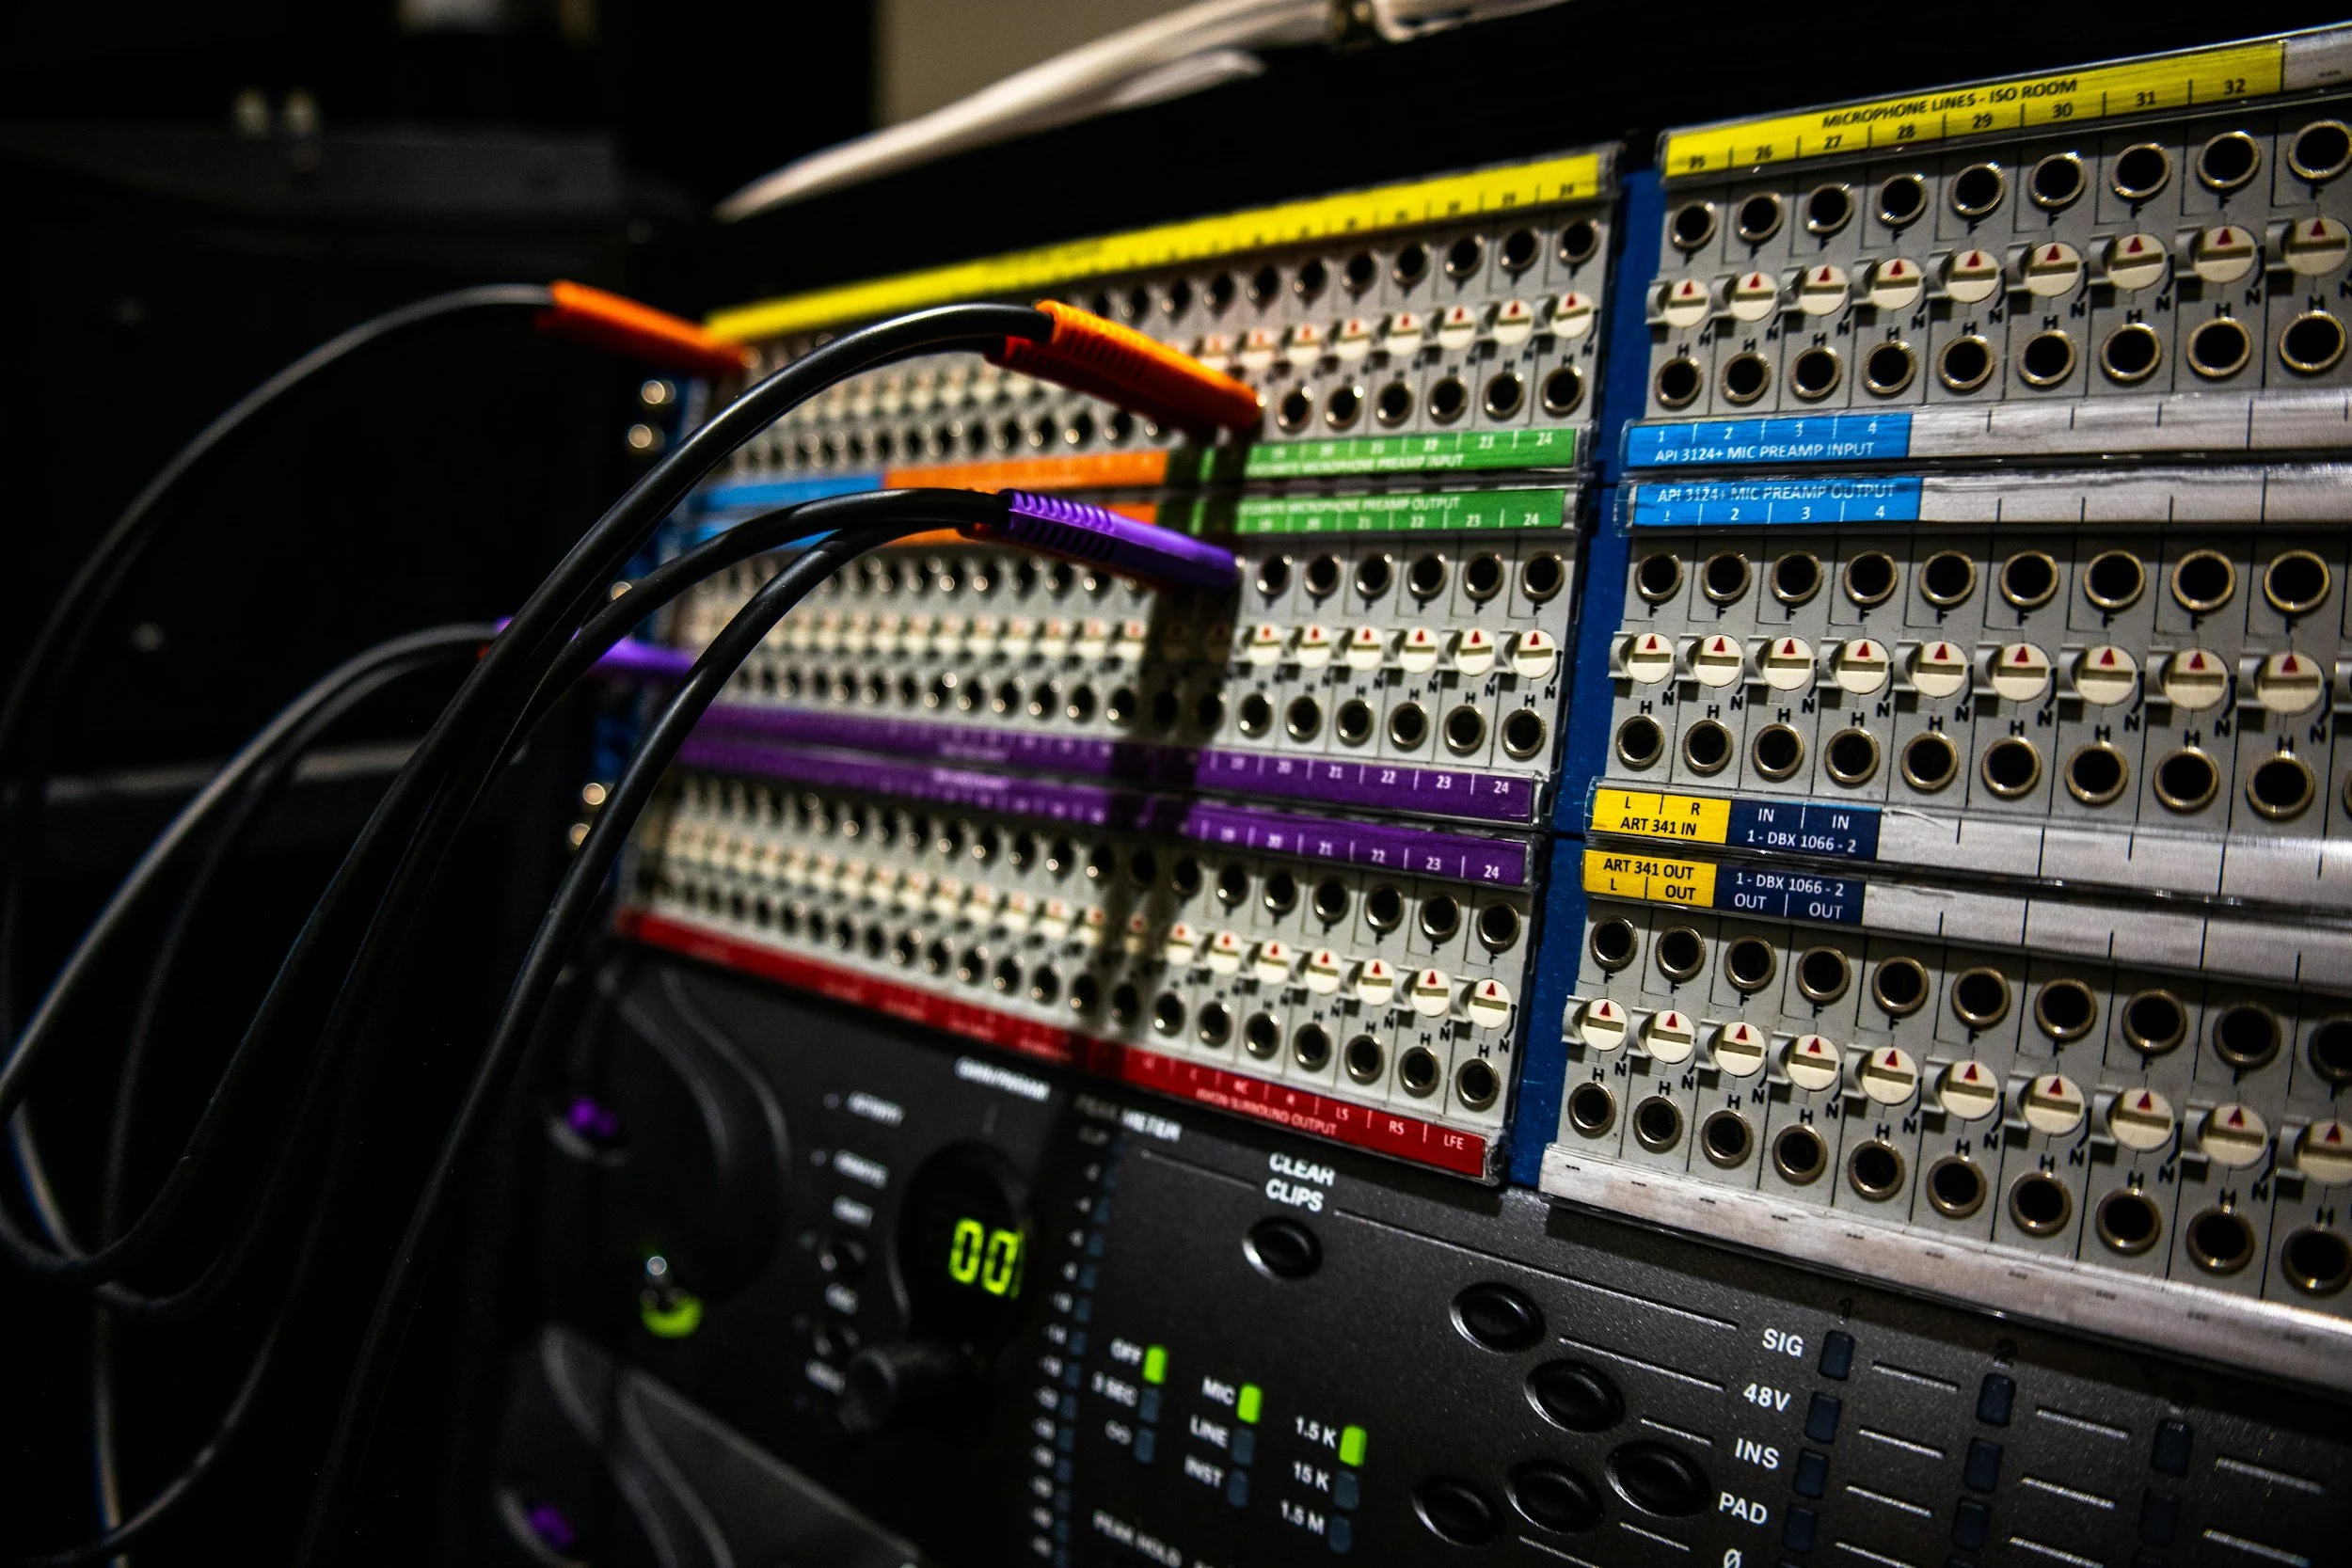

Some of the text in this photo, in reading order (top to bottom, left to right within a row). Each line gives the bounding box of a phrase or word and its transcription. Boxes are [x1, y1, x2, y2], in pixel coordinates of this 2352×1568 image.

[2224, 78, 2246, 95] 32
[1822, 99, 1928, 128] MICROPHONE
[1931, 92, 1975, 115] LINES
[1989, 85, 2017, 105] ISO
[2022, 78, 2077, 99] ROOM
[2136, 91, 2156, 106] 31
[2052, 102, 2073, 118] 30
[1972, 114, 1994, 130] 29
[1823, 134, 1843, 150] 27
[2156, 295, 2169, 310] N
[2246, 289, 2260, 305] N
[2309, 295, 2325, 309] H
[2072, 302, 2085, 317] N
[2127, 309, 2142, 324] H
[2216, 303, 2232, 317] H
[2043, 315, 2058, 329] H
[1724, 426, 1733, 439] 2
[1794, 422, 1804, 437] 3
[1867, 420, 1878, 434] 4
[1536, 432, 1552, 447] 24
[1658, 430, 1665, 442] 1
[1655, 441, 1874, 462] API 3124+ MIC PREAMP INPUT
[1426, 453, 1465, 468] INPUT
[1658, 483, 1895, 502] API 3124+ MIC PREAMP OUTPUT
[1412, 497, 1461, 511] OUTPUT
[1875, 505, 1884, 518] 4
[1523, 513, 1539, 526] 24
[1731, 508, 1740, 520] 2
[1802, 507, 1811, 519] 3
[1466, 515, 1482, 528] 23
[1663, 691, 1675, 705] N
[1731, 696, 1742, 710] N
[1640, 701, 1652, 714] H
[1708, 705, 1720, 719] H
[1803, 699, 1815, 713] N
[1877, 703, 1890, 717] N
[1778, 708, 1790, 722] H
[1851, 712, 1864, 726] H
[1956, 707, 1969, 721] N
[2037, 710, 2052, 726] N
[1930, 716, 1943, 732] H
[2010, 721, 2024, 736] H
[2124, 716, 2139, 731] N
[2215, 721, 2231, 737] N
[2095, 725, 2110, 740] H
[2185, 730, 2200, 746] H
[2311, 725, 2326, 743] N
[2278, 736, 2294, 752] H
[1327, 765, 1343, 779] 21
[1380, 769, 1396, 784] 22
[1436, 775, 1452, 789] 23
[1494, 780, 1509, 794] 24
[1624, 796, 1631, 809] L
[1691, 802, 1701, 816] R
[1757, 807, 1774, 822] IN
[1620, 816, 1697, 836] ART 341 IN
[1832, 815, 1850, 830] IN
[1318, 841, 1333, 856] 21
[1747, 830, 1755, 843] 1
[1767, 832, 1796, 847] DBX
[1800, 835, 1835, 851] 1066
[1847, 839, 1856, 853] 2
[1371, 849, 1386, 863] 22
[1426, 857, 1441, 871] 23
[1484, 864, 1499, 879] 24
[1603, 858, 1694, 880] ART 341 OUT
[1610, 878, 1617, 891] L
[1665, 884, 1696, 900] OUT
[1736, 872, 1743, 885] 1
[1756, 874, 1784, 890] DBX
[1788, 878, 1822, 895] 1066
[1835, 882, 1844, 897] 2
[1734, 893, 1767, 910] OUT
[1808, 902, 1843, 920] OUT
[1593, 1068, 1604, 1082] H
[1614, 1063, 1627, 1077] N
[1659, 1081, 1670, 1095] H
[1682, 1075, 1693, 1089] N
[1727, 1095, 1740, 1108] H
[1752, 1089, 1765, 1103] N
[1335, 1106, 1349, 1121] LS
[1801, 1109, 1813, 1123] H
[1826, 1102, 1838, 1117] N
[1291, 1113, 1337, 1135] OUTPUT
[1389, 1120, 1405, 1135] RS
[1876, 1124, 1889, 1137] H
[1903, 1117, 1916, 1133] N
[1443, 1134, 1464, 1149] LFE
[1269, 1151, 1336, 1186] CLEAR
[1265, 1178, 1325, 1212] CLIPS
[948, 1217, 1020, 1296] 00
[1761, 1327, 1804, 1357] SIG
[1201, 1375, 1236, 1406] MIC
[1742, 1383, 1791, 1412] 48V
[1189, 1414, 1230, 1449] LINE
[1295, 1415, 1337, 1449] 1.5 K
[1734, 1437, 1780, 1469] INS
[1184, 1453, 1225, 1489] INST
[1293, 1460, 1330, 1493] 15 K
[1718, 1491, 1768, 1525] PAD
[1279, 1498, 1326, 1535] 1.5 M
